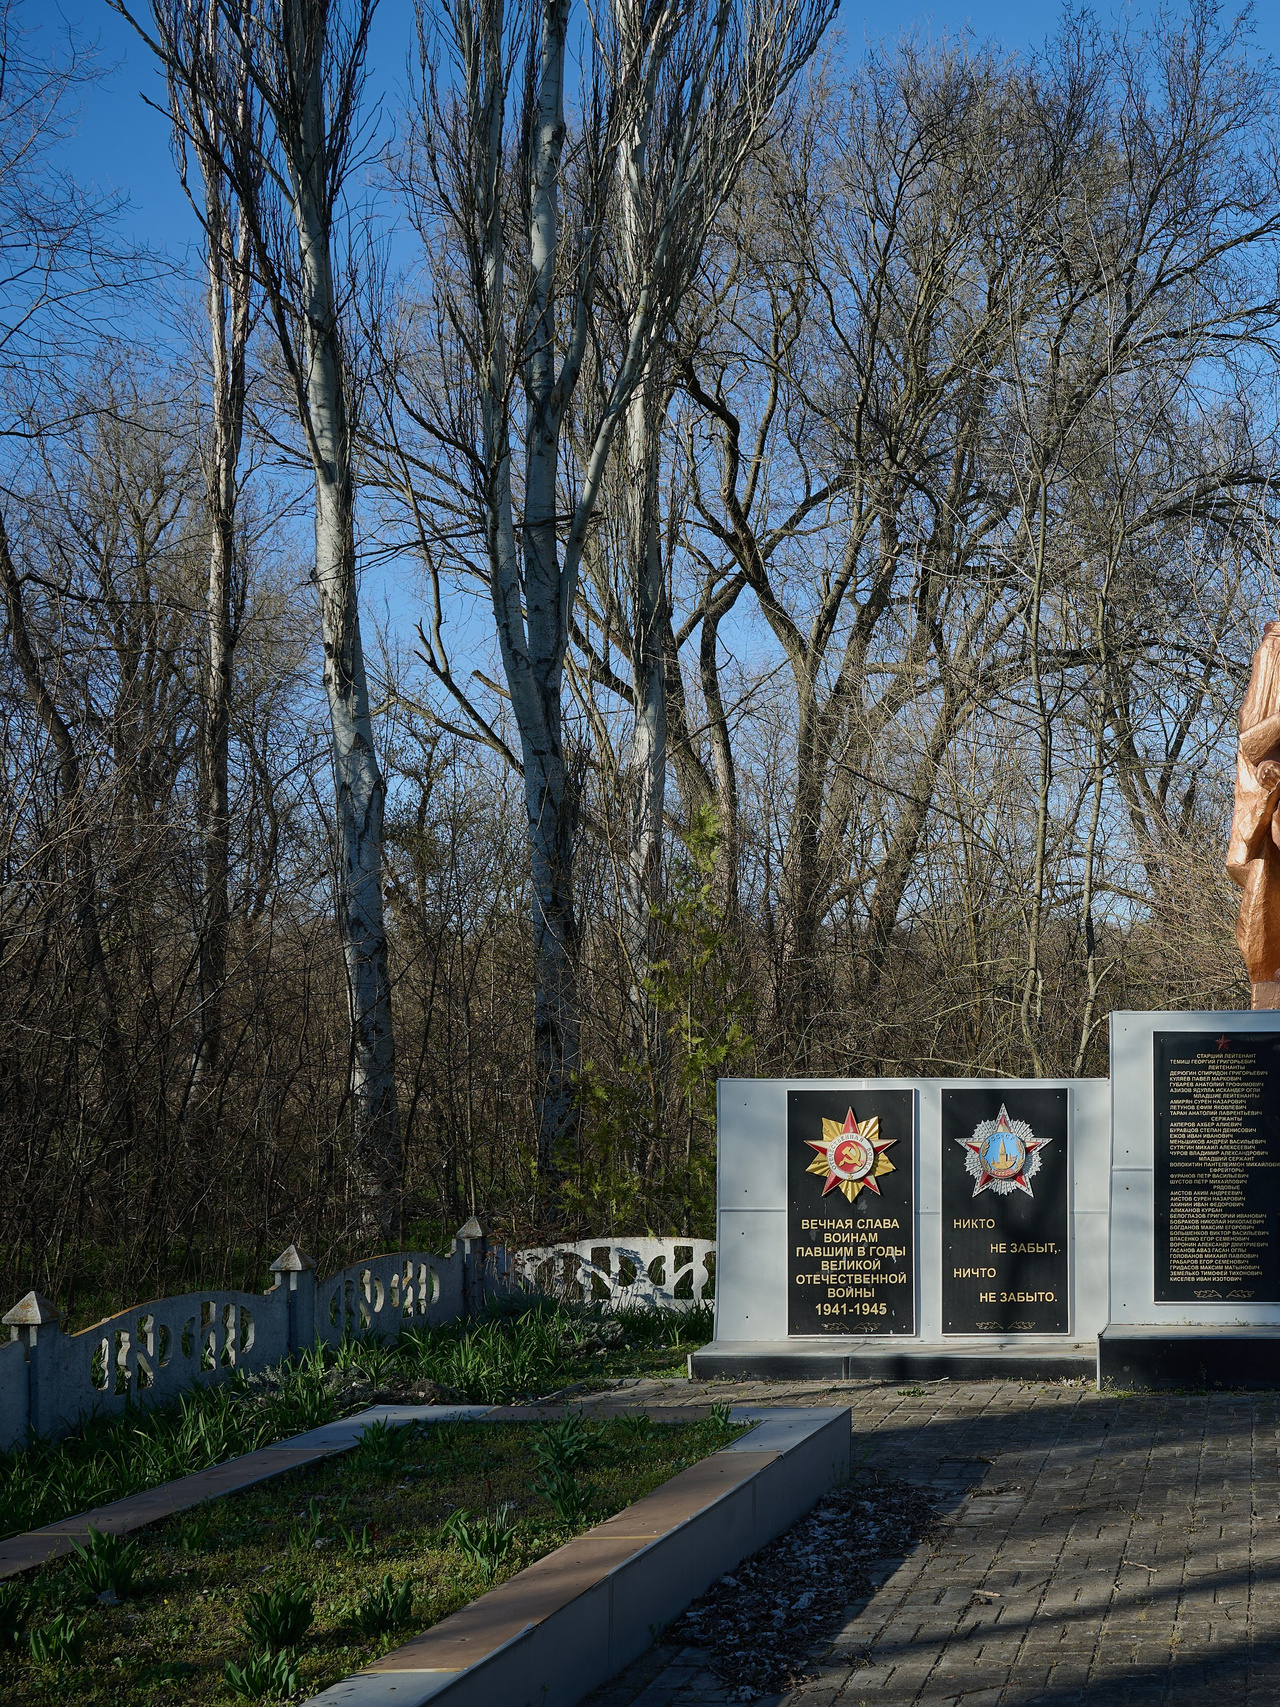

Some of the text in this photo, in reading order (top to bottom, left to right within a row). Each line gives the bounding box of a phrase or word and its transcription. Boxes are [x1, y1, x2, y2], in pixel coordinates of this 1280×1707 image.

[802, 1219, 899, 1229] ВЕЧНАЯ СЛАВА
[954, 1219, 995, 1228] НИКТО
[824, 1233, 877, 1242] ВОИНАМ
[796, 1246, 905, 1259] ПАВШИМ В ГОДЫ
[991, 1243, 1057, 1254] НЕ ЗАБЫТ,
[822, 1258, 880, 1270] ВЕЛИКОЙ
[796, 1271, 906, 1284] ОТЕЧЕСТВЕННОЙ
[954, 1268, 996, 1278] НИЧТО
[828, 1286, 874, 1298] ВОЙНЫ
[980, 1292, 1057, 1302] НЕ ЗАБЫТО.
[816, 1303, 886, 1315] 1941-1945
